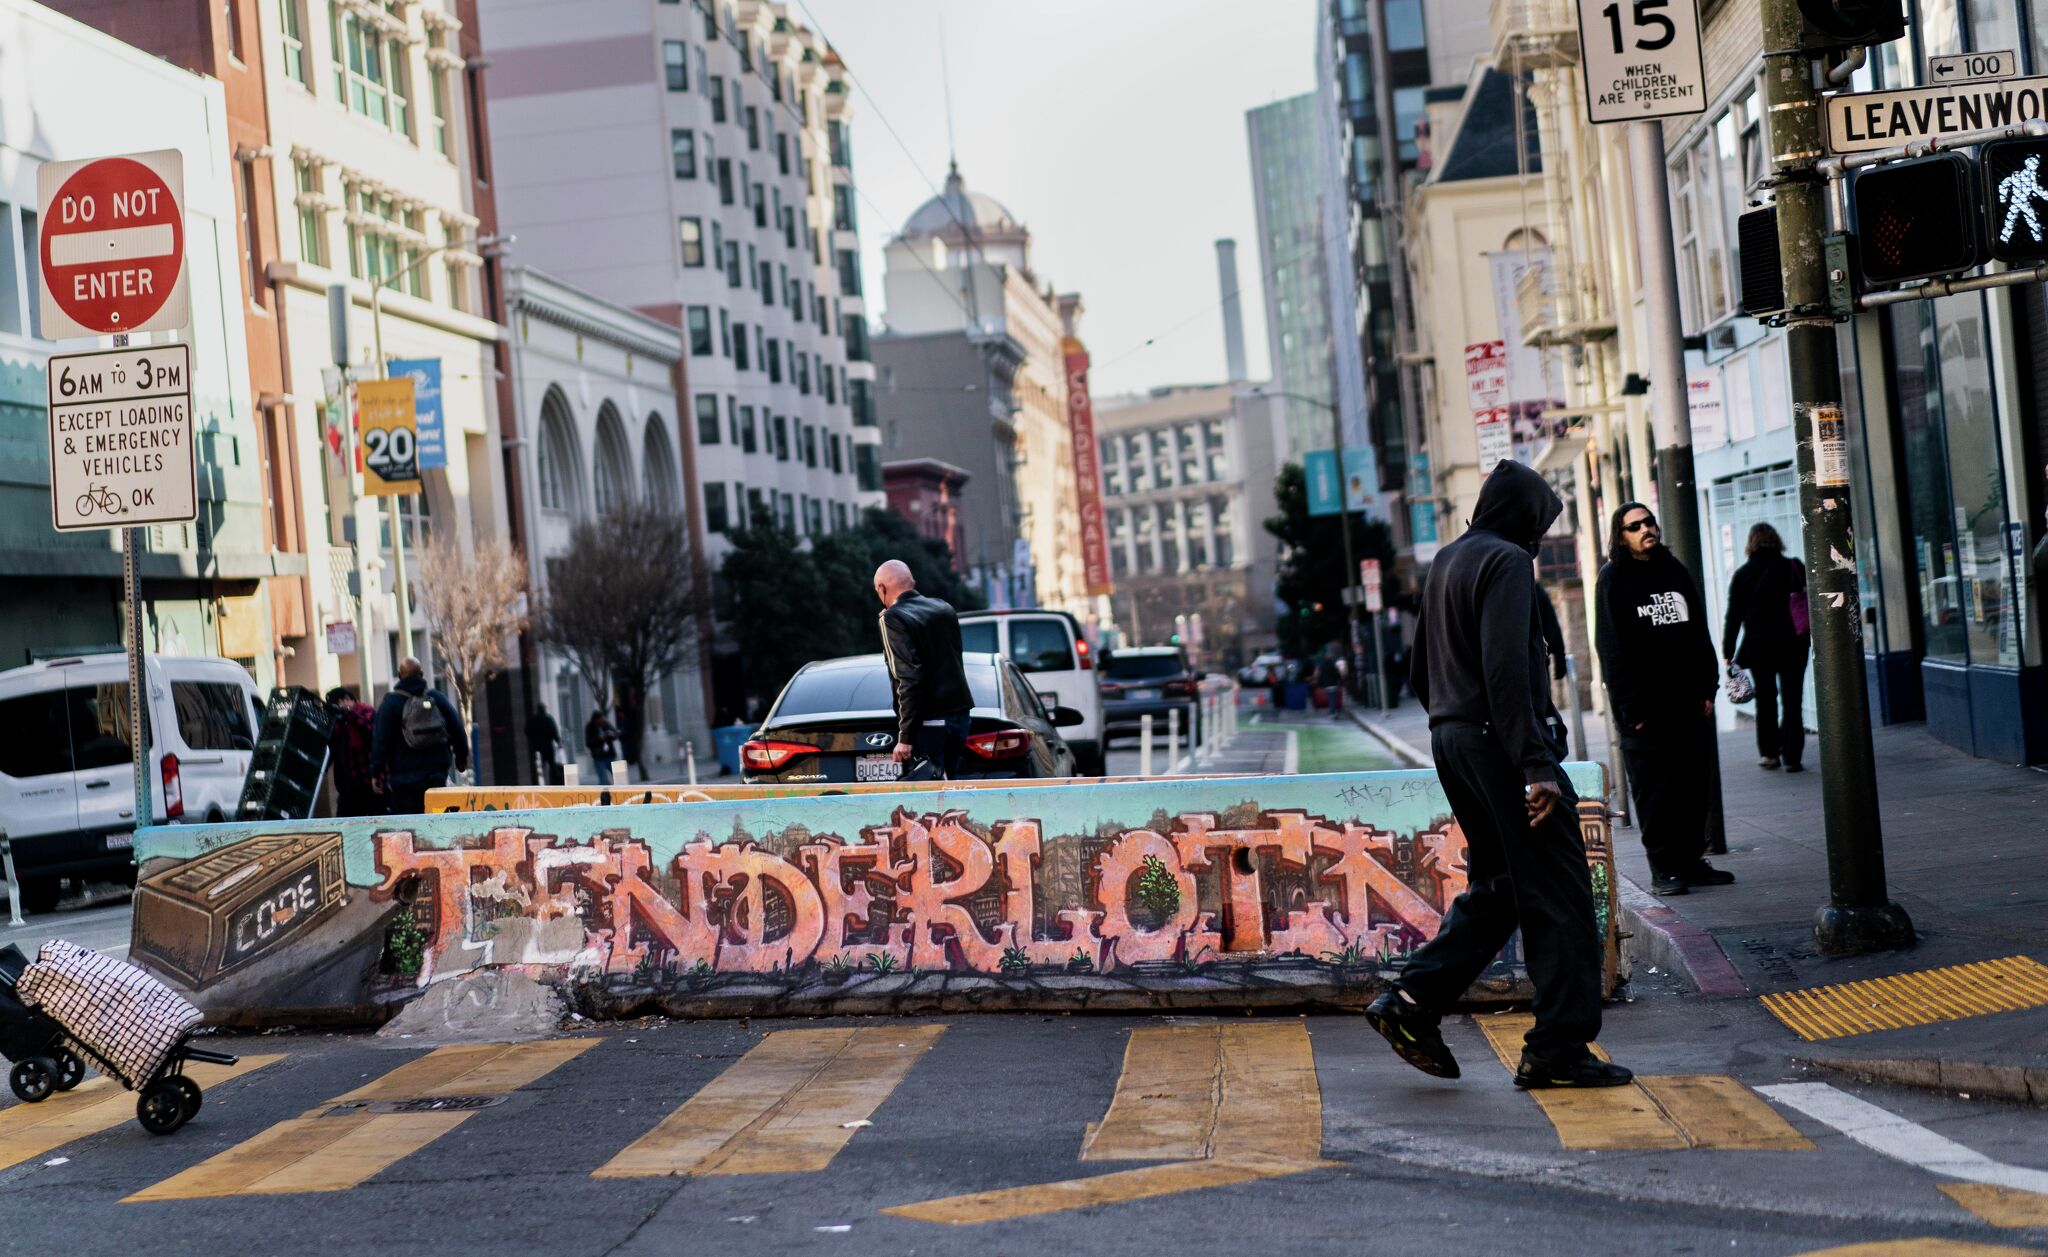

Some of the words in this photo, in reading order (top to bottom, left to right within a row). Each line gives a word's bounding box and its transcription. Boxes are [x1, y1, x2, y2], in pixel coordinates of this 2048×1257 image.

[1603, 0, 1675, 54] 15
[1625, 63, 1662, 77] WHEN
[1964, 55, 2000, 77] 100
[1613, 74, 1677, 91] CHILDREN
[1598, 92, 1625, 105] ARE
[1635, 85, 1694, 101] PRESENT
[1844, 88, 2048, 141] LEAVENWO
[62, 195, 96, 224] DO
[113, 187, 160, 219] NOT
[74, 268, 153, 301] ENTER
[59, 366, 102, 396] 6AM
[111, 370, 126, 384] TO
[136, 358, 181, 390] 3PM
[59, 410, 112, 431] EXCEPT
[120, 404, 183, 427] LOADING
[64, 437, 77, 455] &
[86, 428, 181, 453] EMERGENCY
[365, 427, 414, 465] 20
[83, 453, 163, 477] VEHICLES
[1070, 369, 1094, 492] GOLDEN
[1082, 503, 1101, 584] GATE
[132, 488, 155, 506] OK
[1637, 602, 1675, 617] NORTH
[1650, 592, 1673, 604] THE
[1652, 612, 1678, 626] FACE
[787, 773, 827, 781] SONATA
